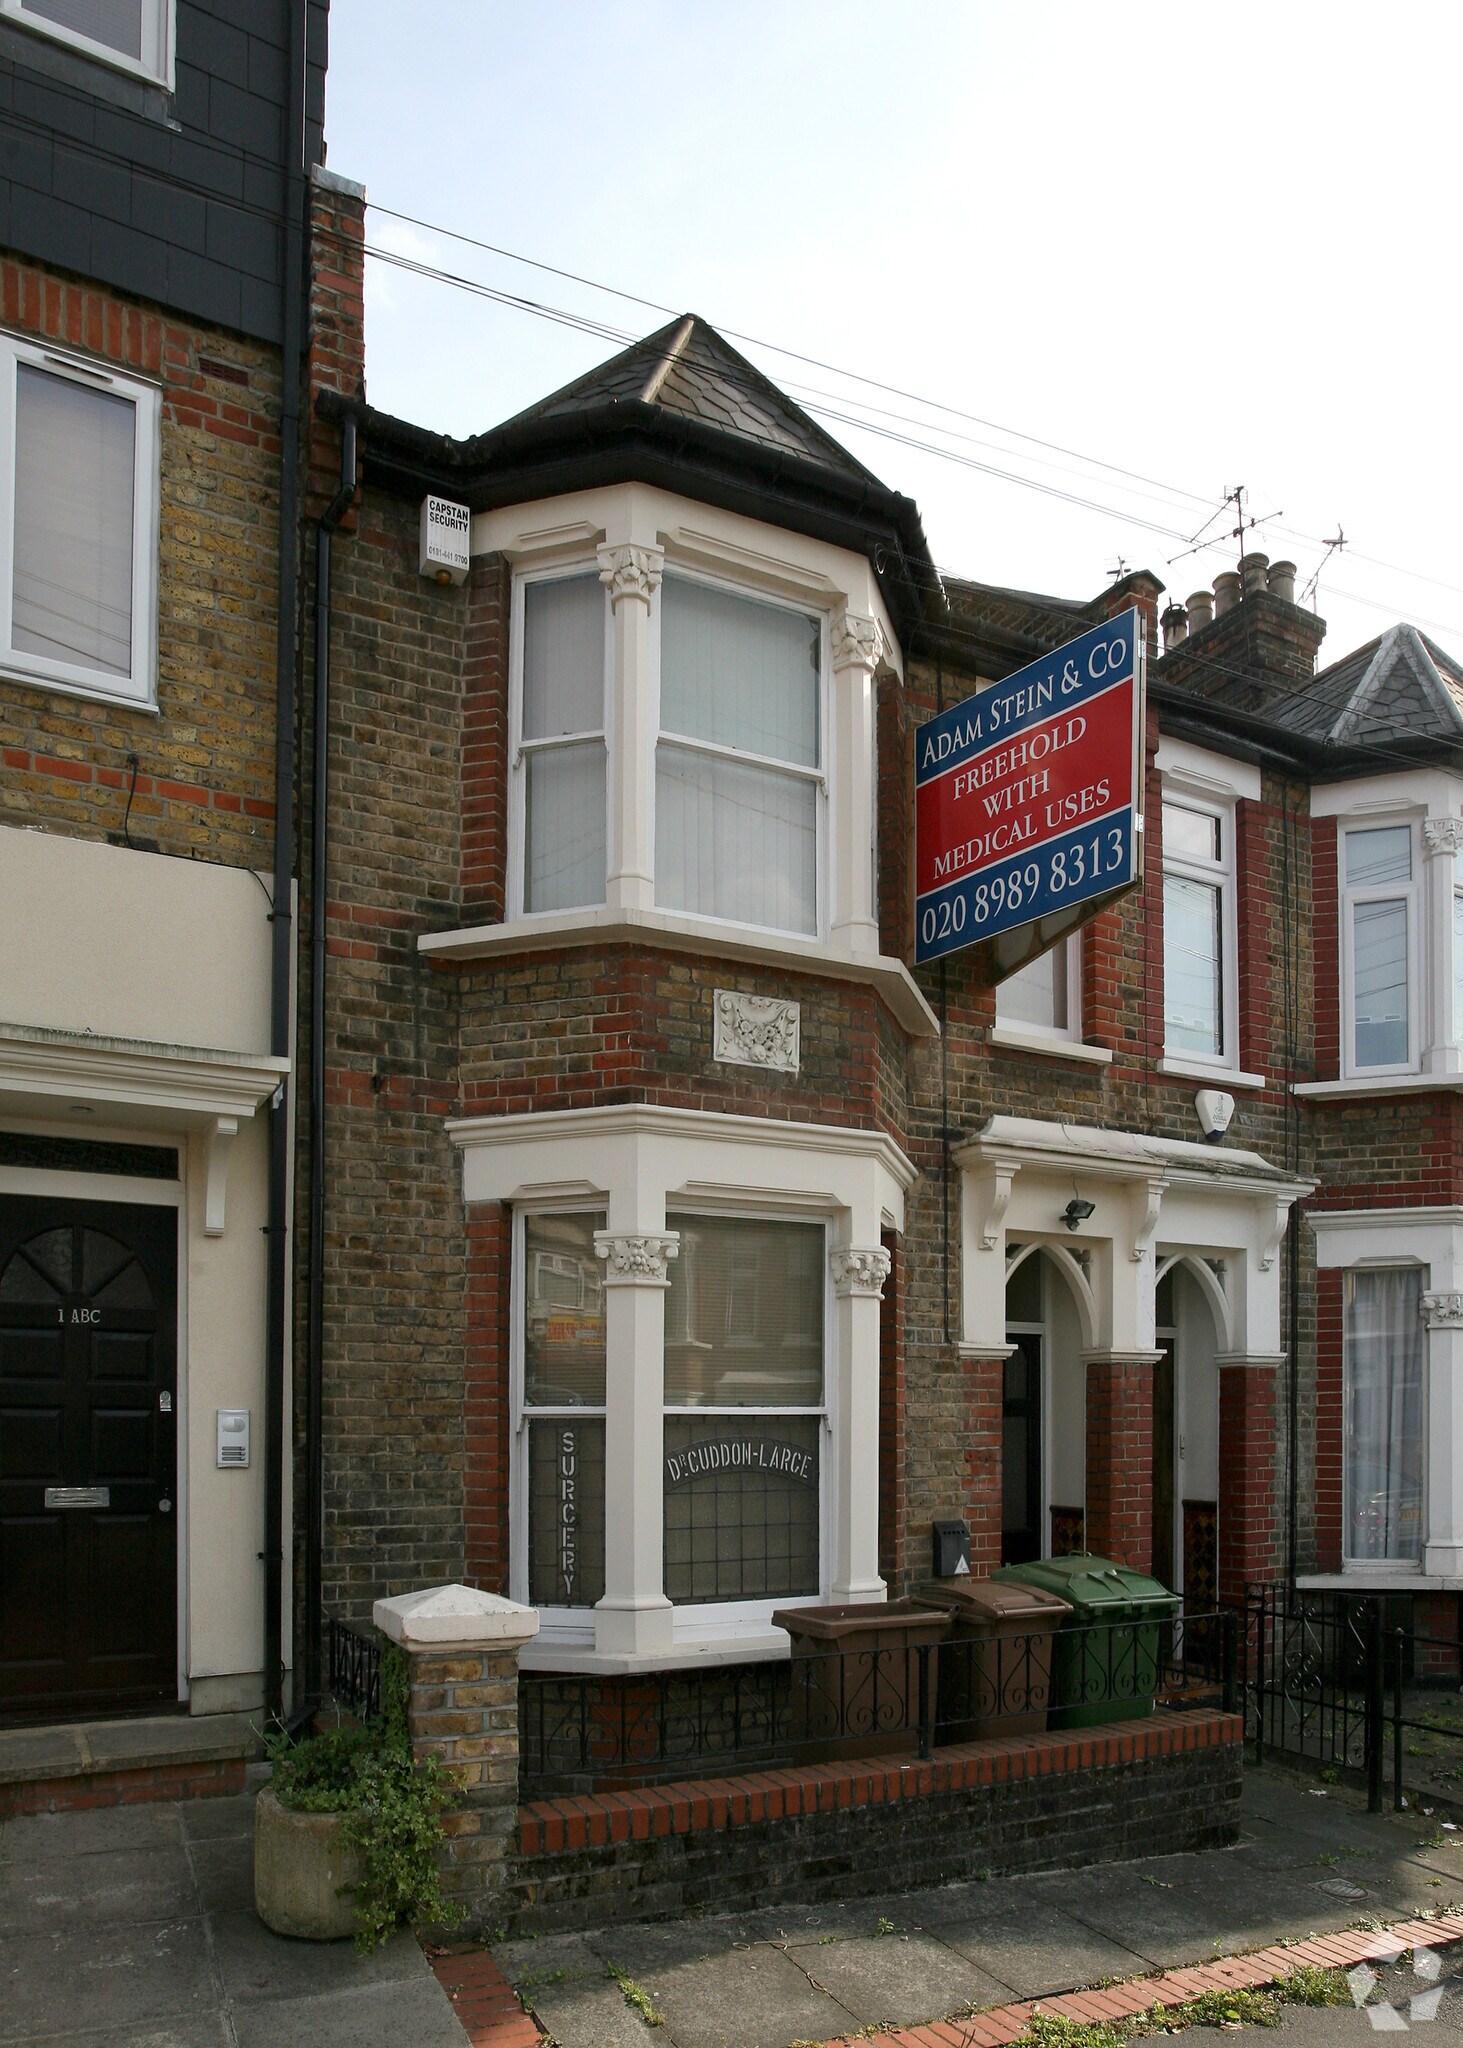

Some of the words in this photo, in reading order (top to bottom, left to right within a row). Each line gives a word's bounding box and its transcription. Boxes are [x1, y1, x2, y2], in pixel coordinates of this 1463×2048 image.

[429, 500, 468, 521] CAPSTAN
[429, 512, 468, 532] SECURITY
[921, 713, 983, 769] ADAM
[990, 674, 1054, 731] STEIN
[1061, 659, 1083, 694] &
[953, 716, 1087, 800] FREEHOLD
[982, 768, 1050, 819] WITH
[933, 813, 1038, 880] MEDICAL
[1045, 778, 1110, 827] USES
[922, 895, 967, 944] 020
[974, 863, 1040, 924] 8989
[1050, 828, 1123, 893] 8313
[71, 1308, 101, 1323] ABC
